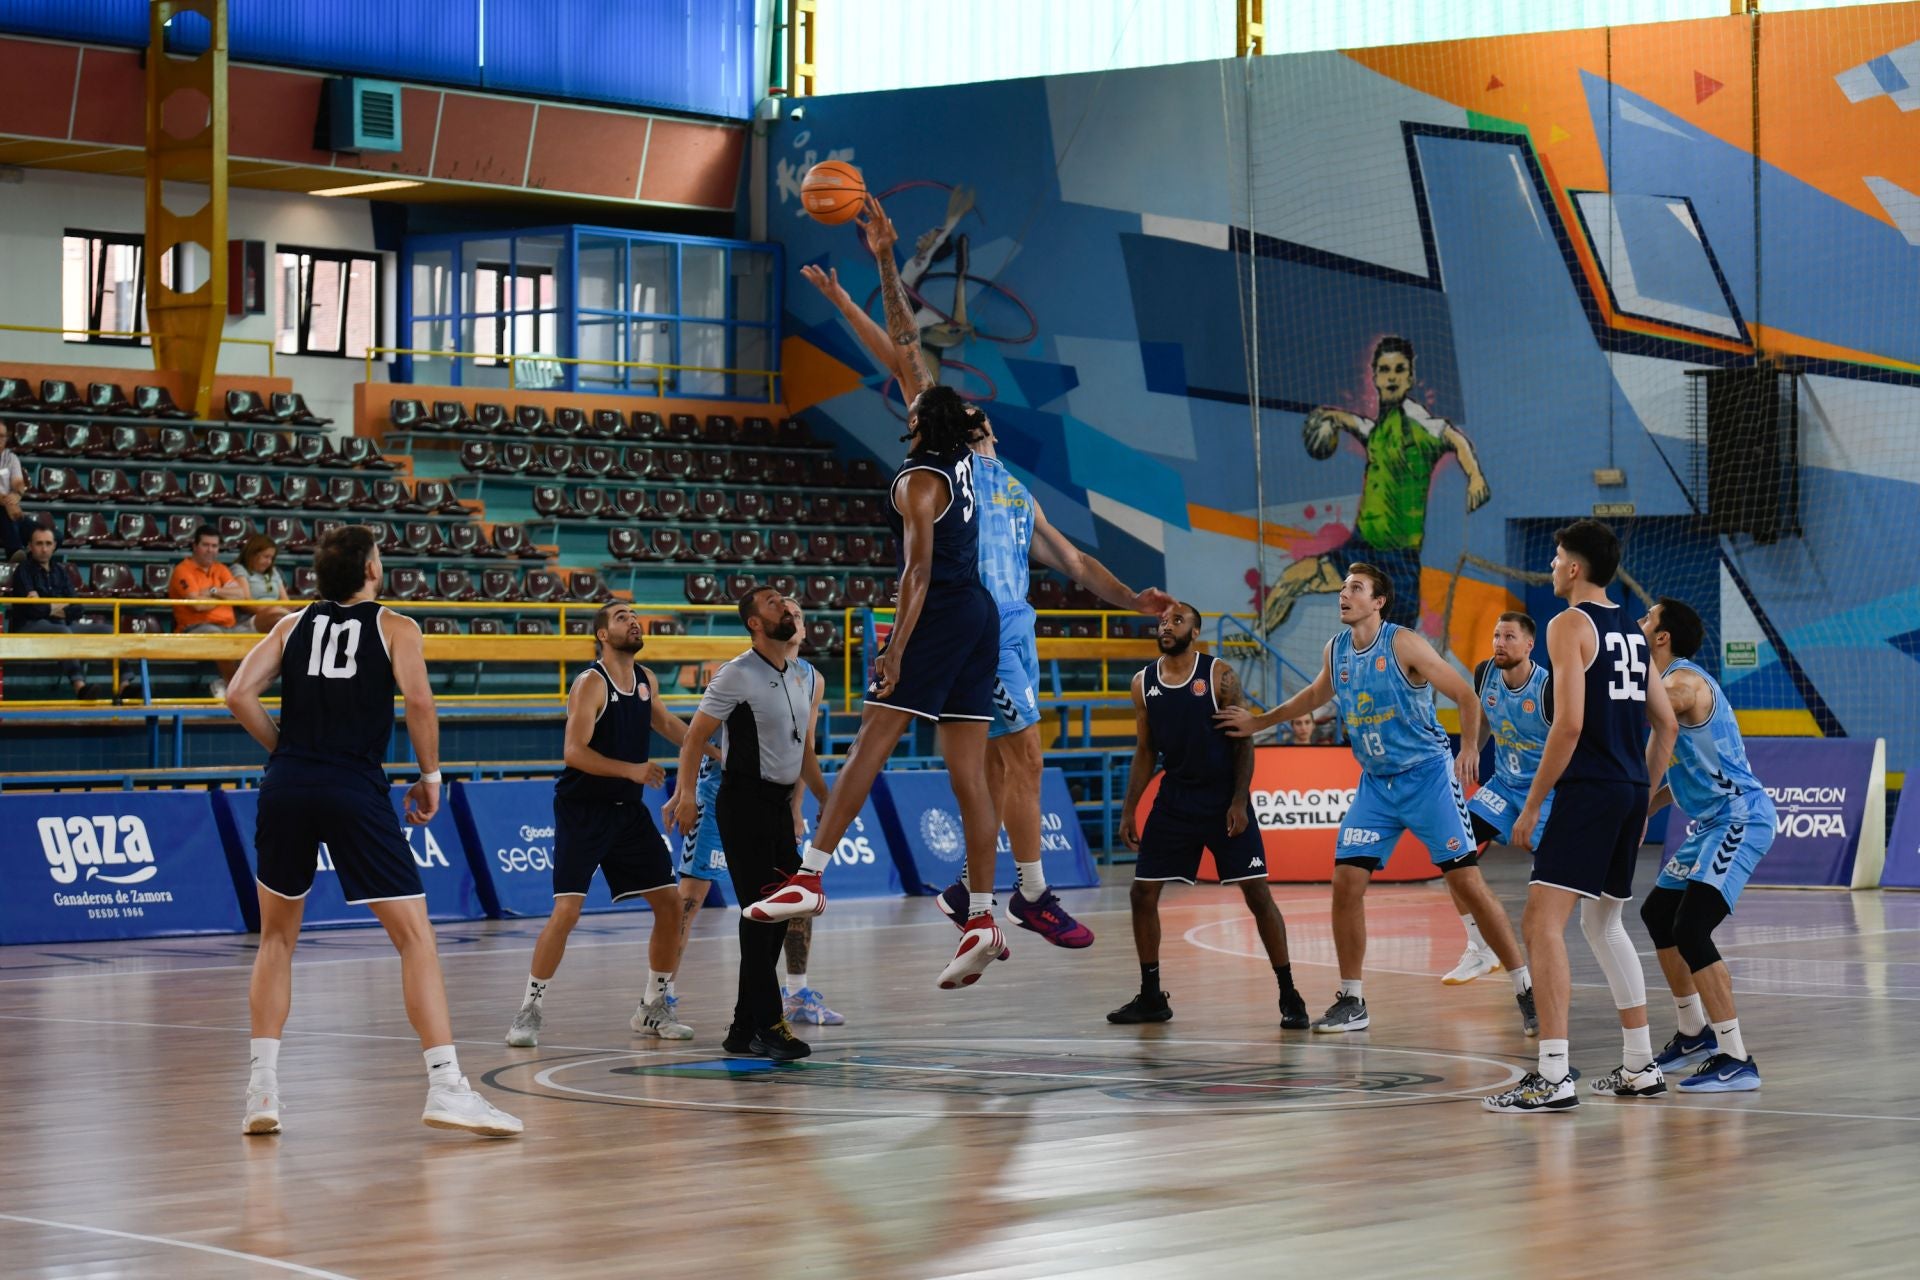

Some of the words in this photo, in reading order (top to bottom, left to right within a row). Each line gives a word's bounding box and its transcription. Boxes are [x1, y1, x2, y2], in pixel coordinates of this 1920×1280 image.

[1009, 516, 1026, 545] 15
[307, 614, 362, 679] 10
[1605, 632, 1647, 702] 35
[1362, 733, 1385, 757] 13
[1508, 753, 1522, 774] 8
[1776, 814, 1847, 838] MORA
[37, 815, 155, 884] gaza
[53, 891, 114, 906] Ganaderos
[115, 890, 129, 904] de
[130, 889, 173, 903] Zamora
[88, 908, 120, 919] DESDE
[122, 907, 144, 918] 1966
